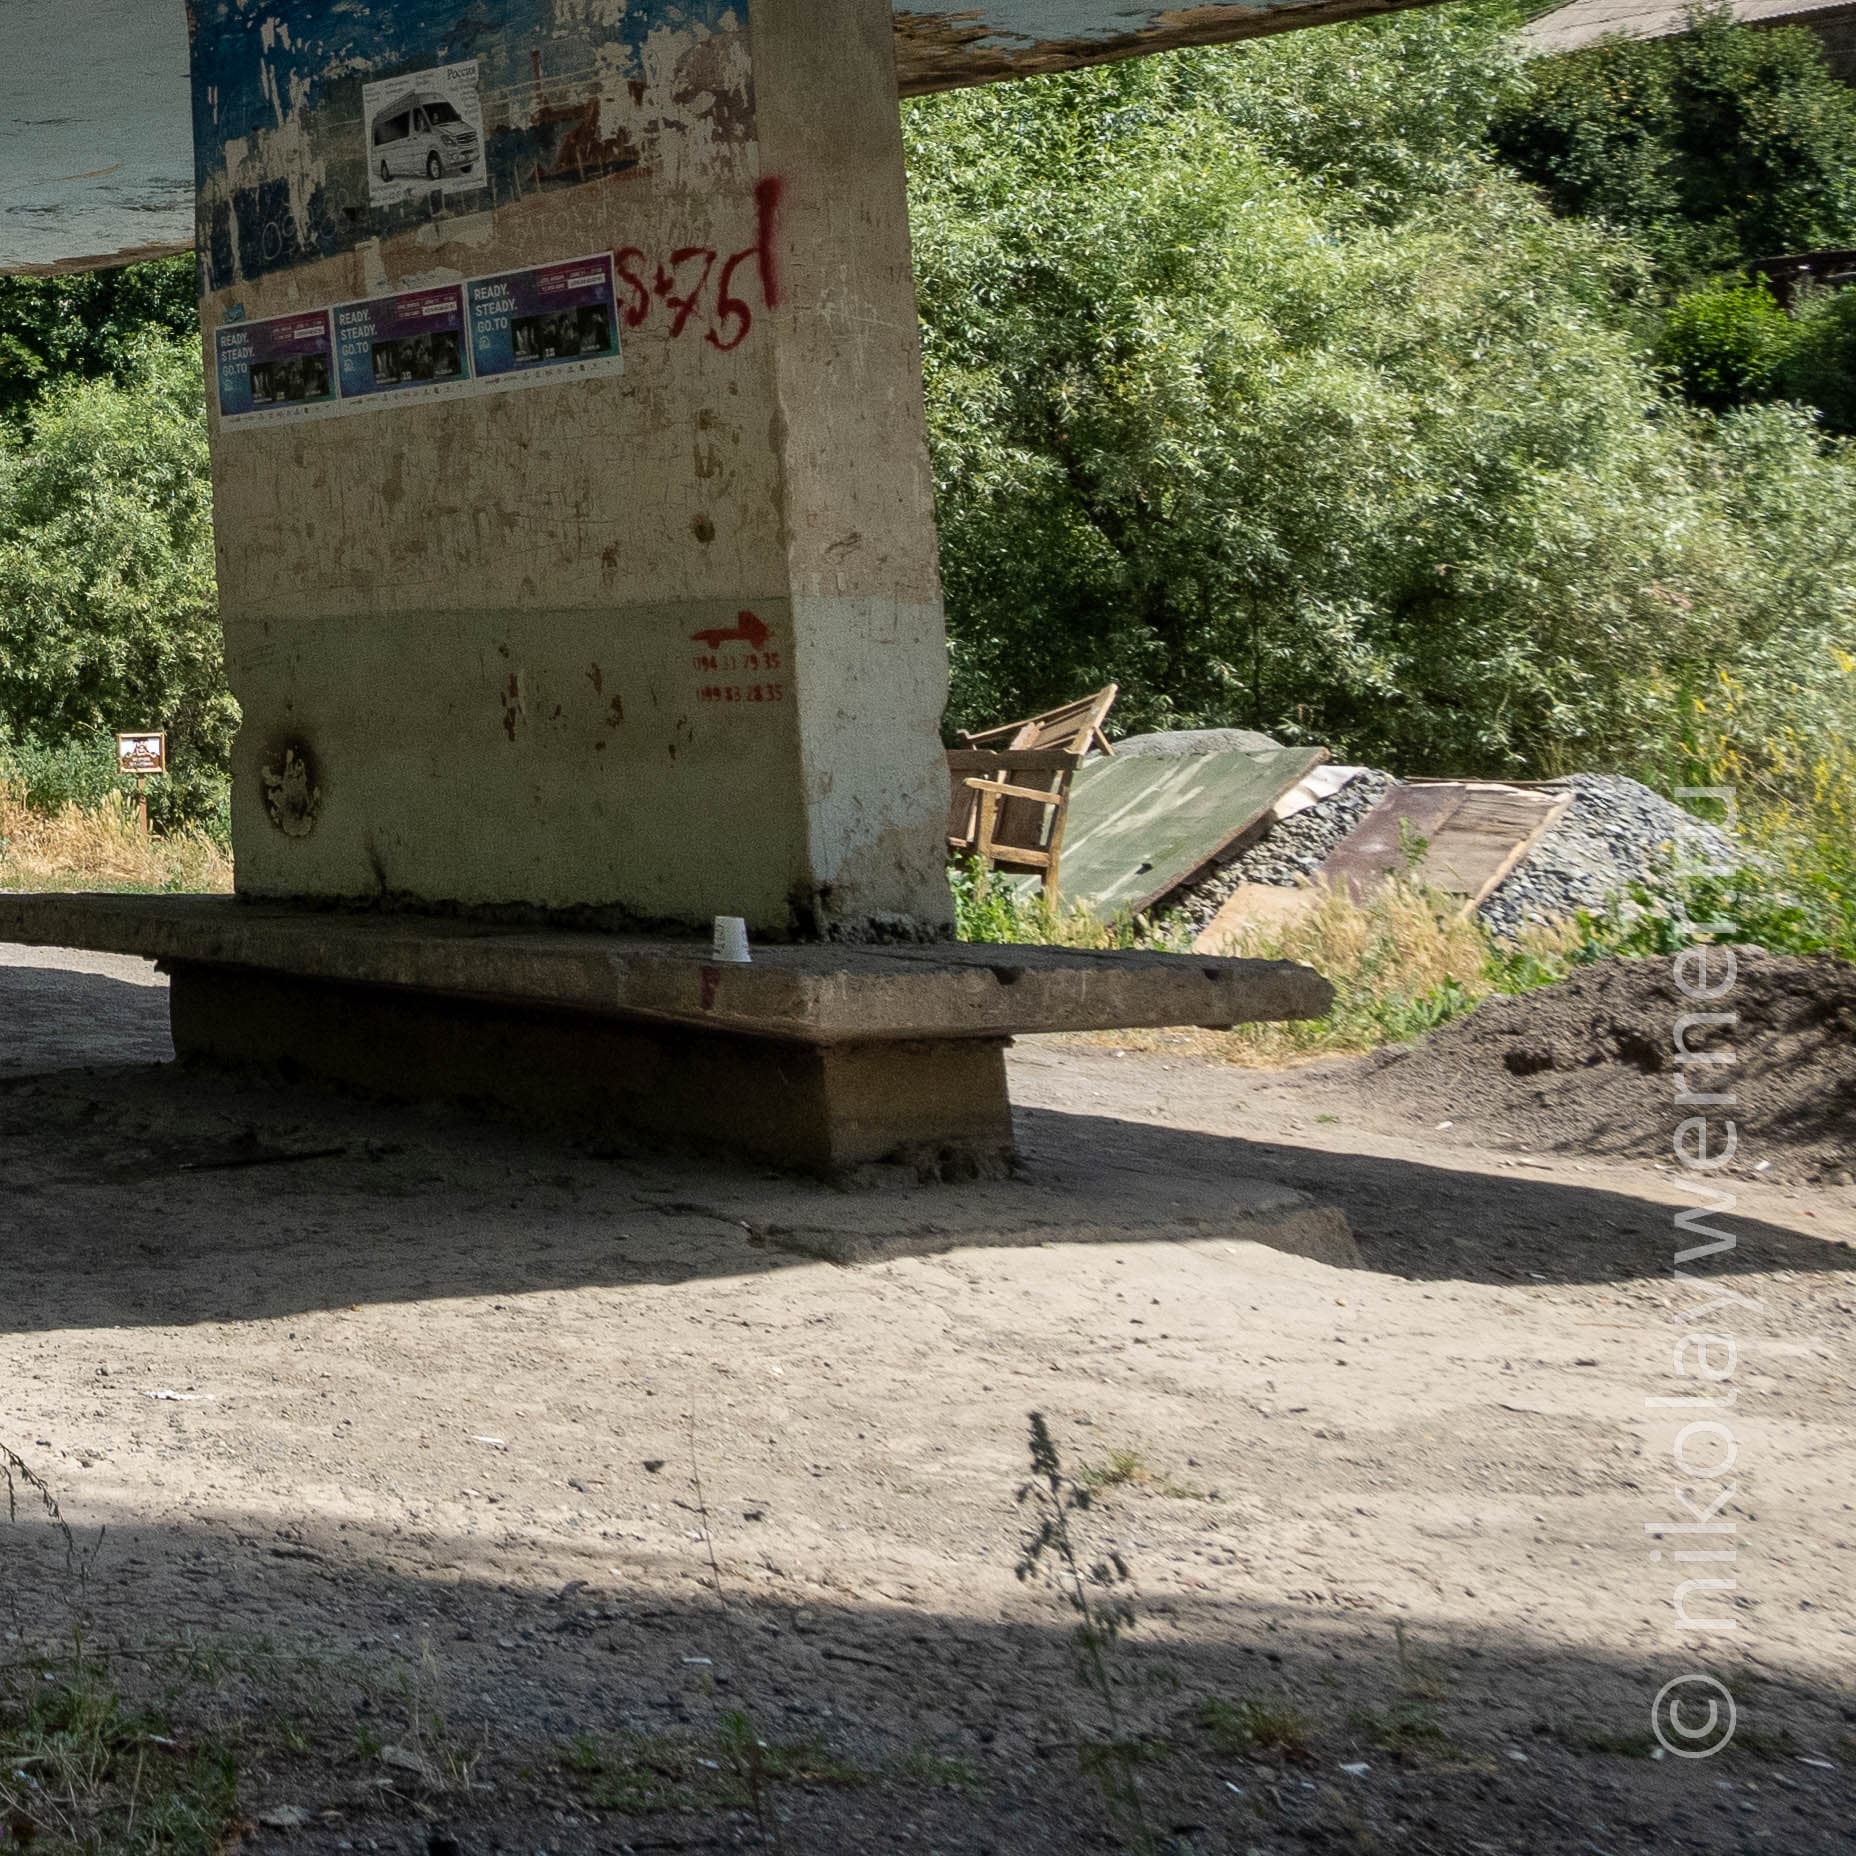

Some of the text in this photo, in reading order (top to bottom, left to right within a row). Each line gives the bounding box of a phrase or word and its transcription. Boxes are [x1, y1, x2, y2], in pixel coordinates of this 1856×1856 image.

[474, 283, 510, 301] READY.
[475, 298, 518, 317] STEADY.
[339, 309, 371, 325] READY.
[477, 316, 508, 333] GO.TO
[220, 332, 249, 347] READY.
[340, 324, 377, 341] STEADY.
[221, 346, 255, 362] STEADY.
